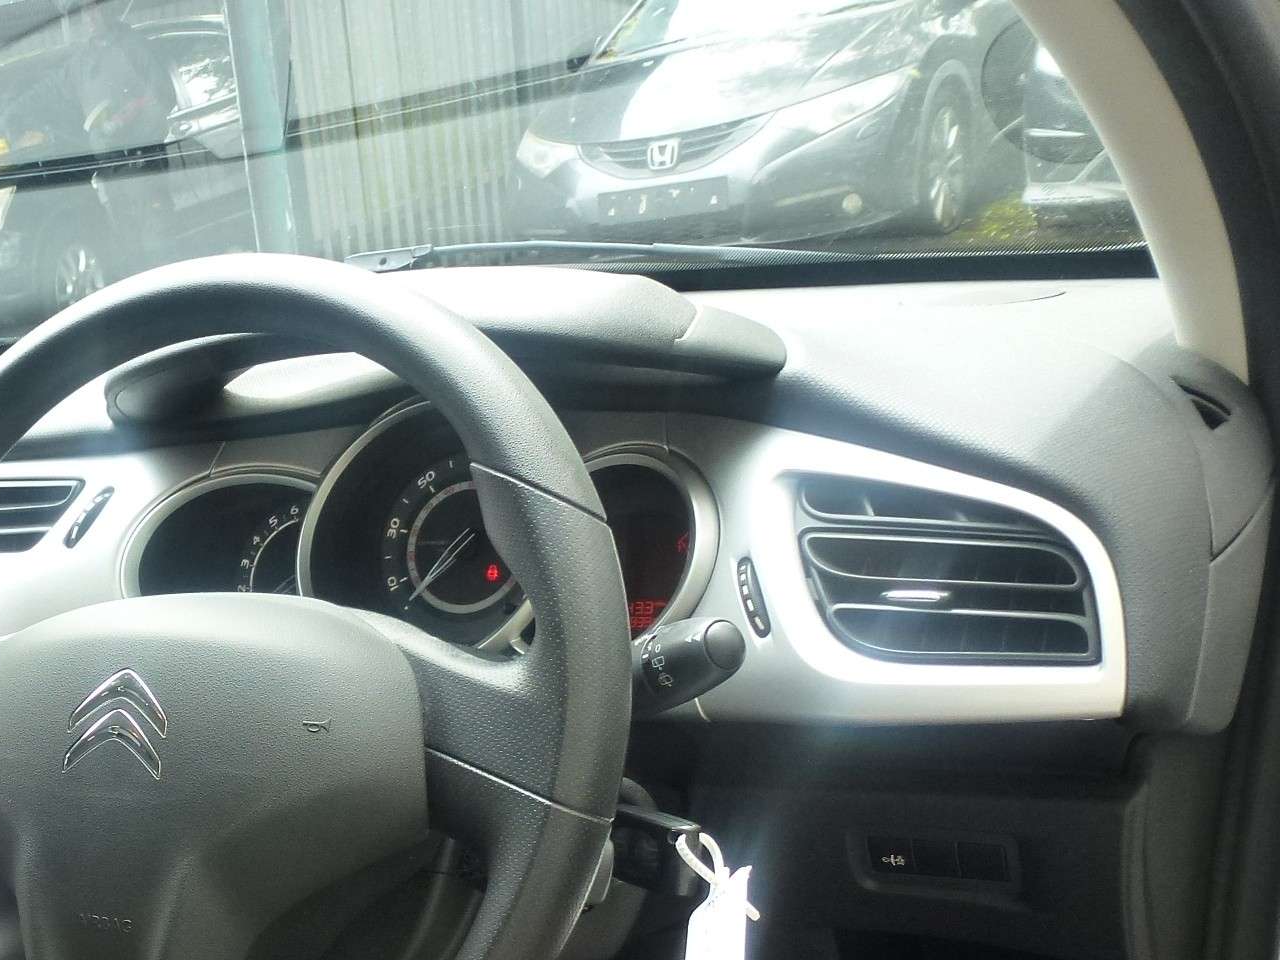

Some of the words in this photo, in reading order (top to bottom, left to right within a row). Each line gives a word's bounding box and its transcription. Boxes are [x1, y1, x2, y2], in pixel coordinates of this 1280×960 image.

[417, 470, 436, 489] 50
[290, 505, 299, 515] 6
[268, 515, 278, 528] 5
[387, 518, 401, 538] 30
[240, 558, 249, 569] 3
[387, 576, 399, 591] 10
